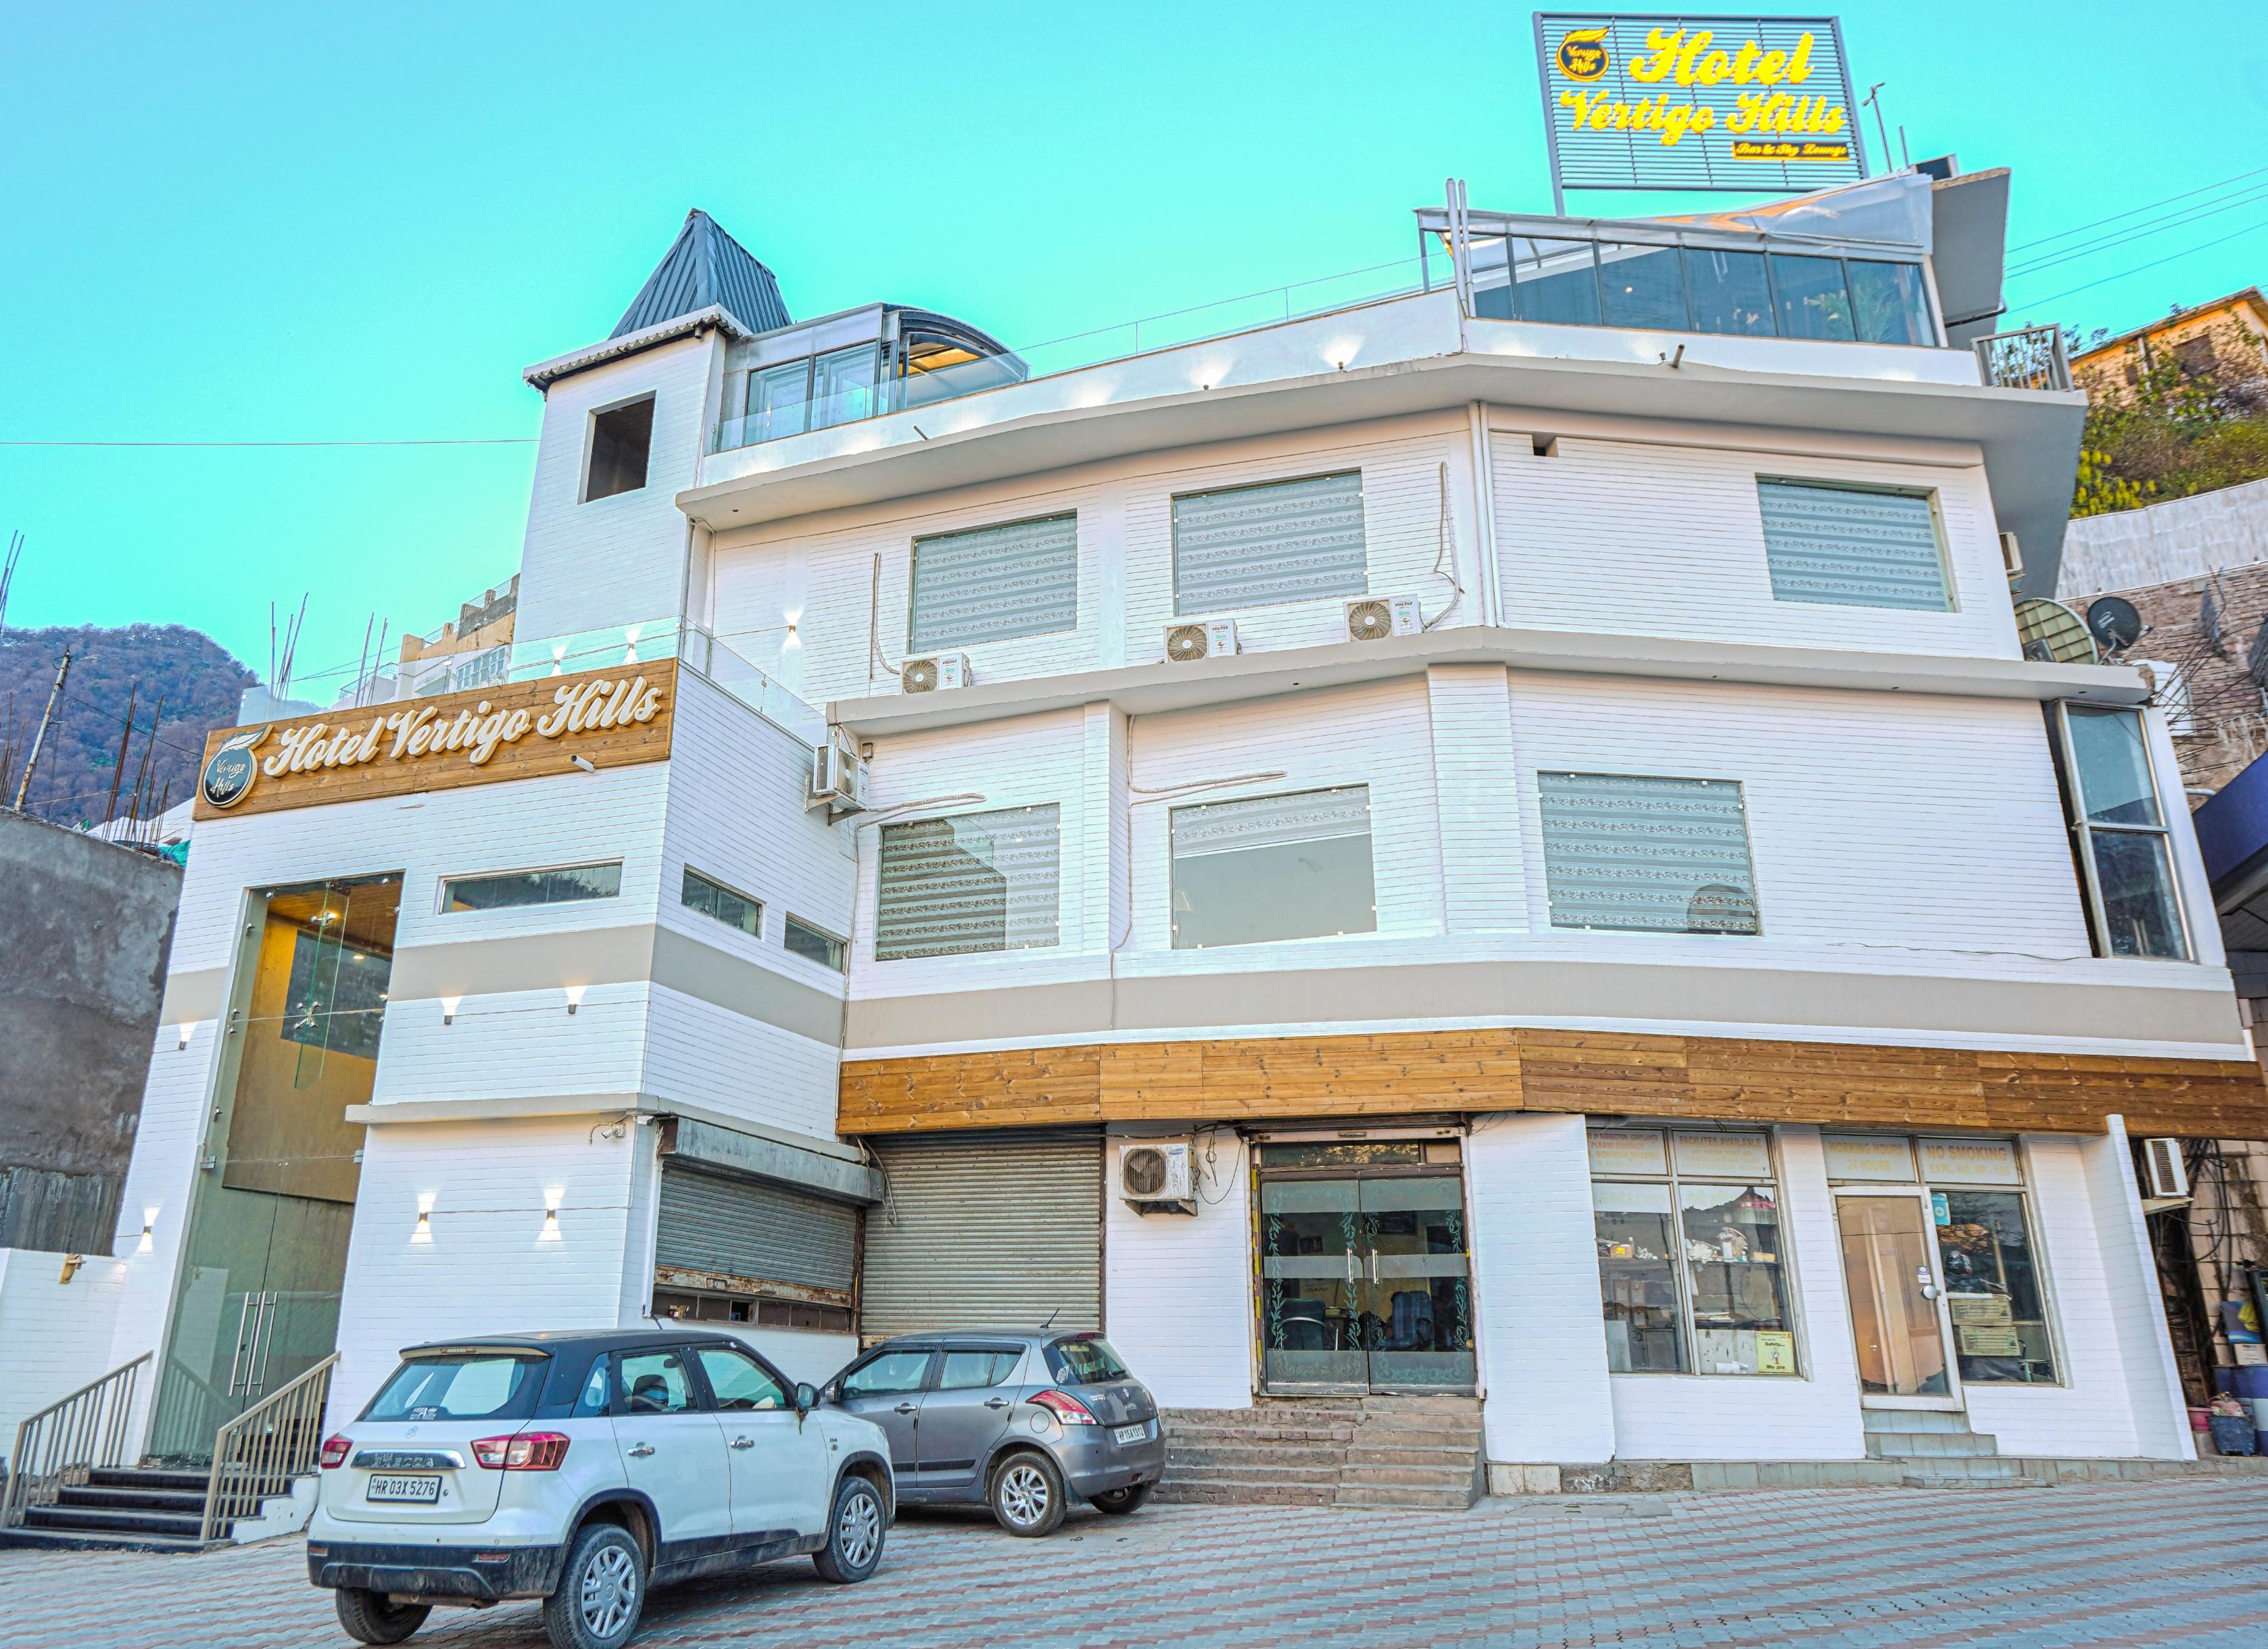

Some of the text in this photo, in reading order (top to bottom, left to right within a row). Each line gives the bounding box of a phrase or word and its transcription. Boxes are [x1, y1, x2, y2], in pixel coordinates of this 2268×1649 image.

[1628, 27, 1814, 87] Hotel
[1569, 57, 1597, 74] Hills
[1559, 89, 1846, 146] Vertigo Hills
[1737, 143, 1762, 154] Bar
[1776, 143, 1800, 157] Sky
[1802, 143, 1848, 157] Lounge
[264, 676, 664, 777] Hotel Vertigo Hills
[216, 759, 246, 779] Vertigo
[210, 777, 235, 797] Hills
[1720, 1137, 1762, 1148] AVAILABLE
[1828, 1141, 1904, 1155] WORKING HOURS
[1925, 1145, 2009, 1160] NO SMOKING
[1860, 1159, 1891, 1171] HOURS
[375, 1480, 388, 1494] HR
[389, 1481, 409, 1496] 03X
[410, 1481, 435, 1496] 5276
